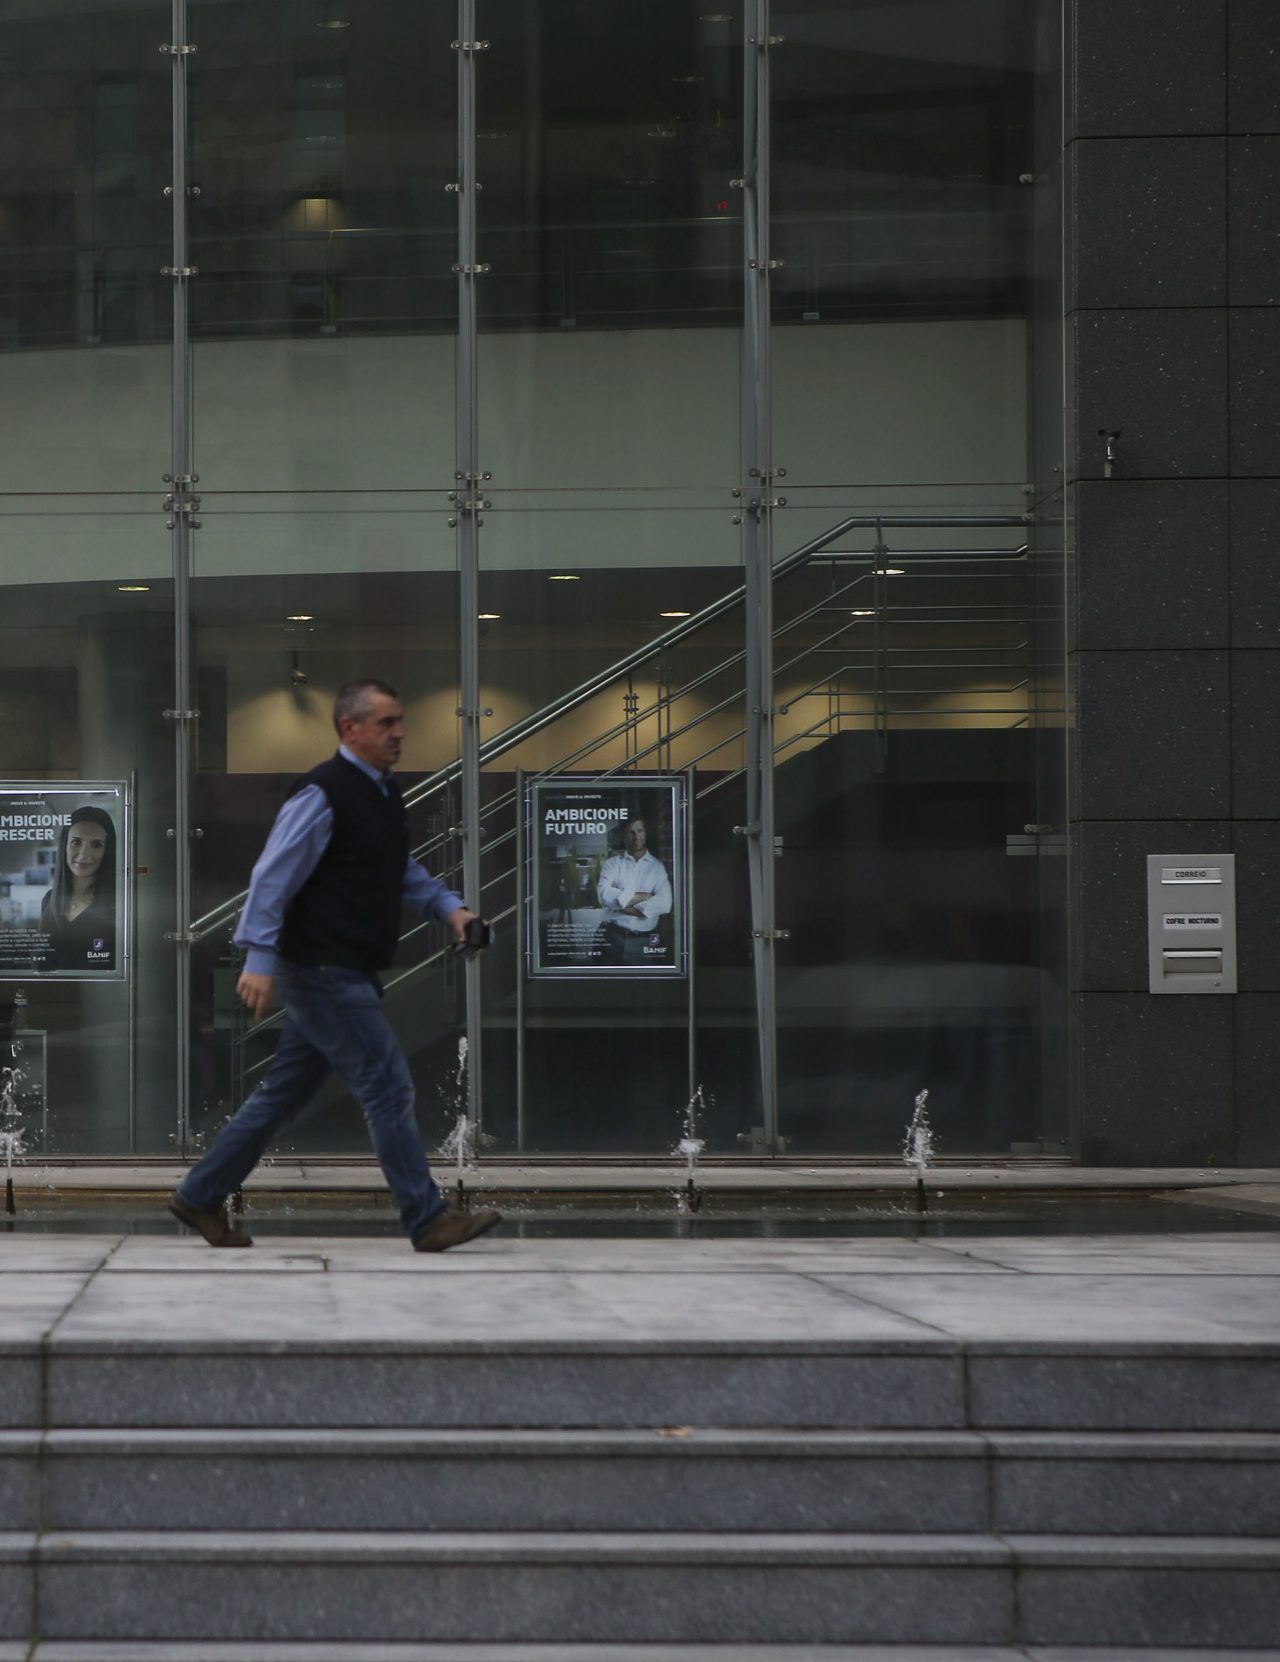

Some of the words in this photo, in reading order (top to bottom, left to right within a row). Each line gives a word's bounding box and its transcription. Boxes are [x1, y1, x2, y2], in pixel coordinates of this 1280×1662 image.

[545, 808, 628, 820] AMBICIONE
[545, 823, 607, 835] FUTURO
[87, 951, 110, 959] BANIF
